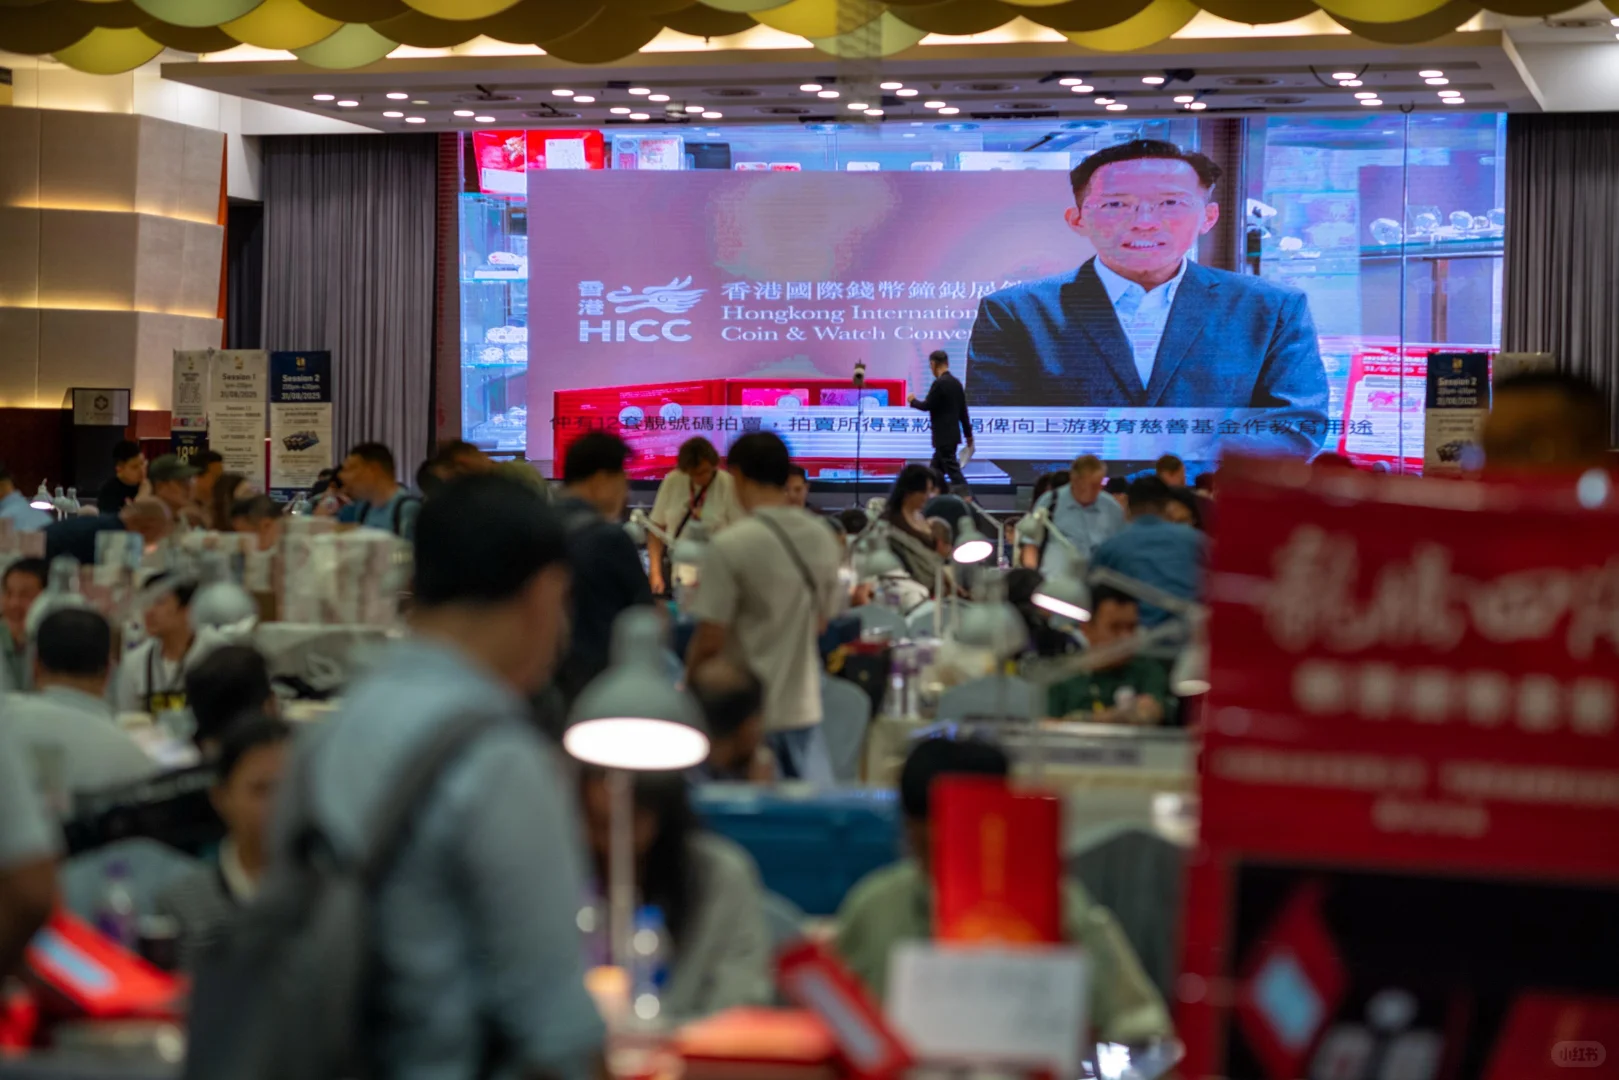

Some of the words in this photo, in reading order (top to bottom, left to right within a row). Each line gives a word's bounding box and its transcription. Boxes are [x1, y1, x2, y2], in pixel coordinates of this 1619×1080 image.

[721, 280, 1024, 302] 香港國際錢幣鐘錶展
[721, 304, 845, 324] Hongkong
[579, 319, 692, 342] HICC
[721, 326, 778, 342] Coin
[786, 326, 806, 341] &
[813, 326, 885, 341] Watch
[282, 374, 313, 382] Session
[314, 374, 320, 382] 2
[1438, 377, 1468, 386] Session
[1470, 377, 1477, 386] 2
